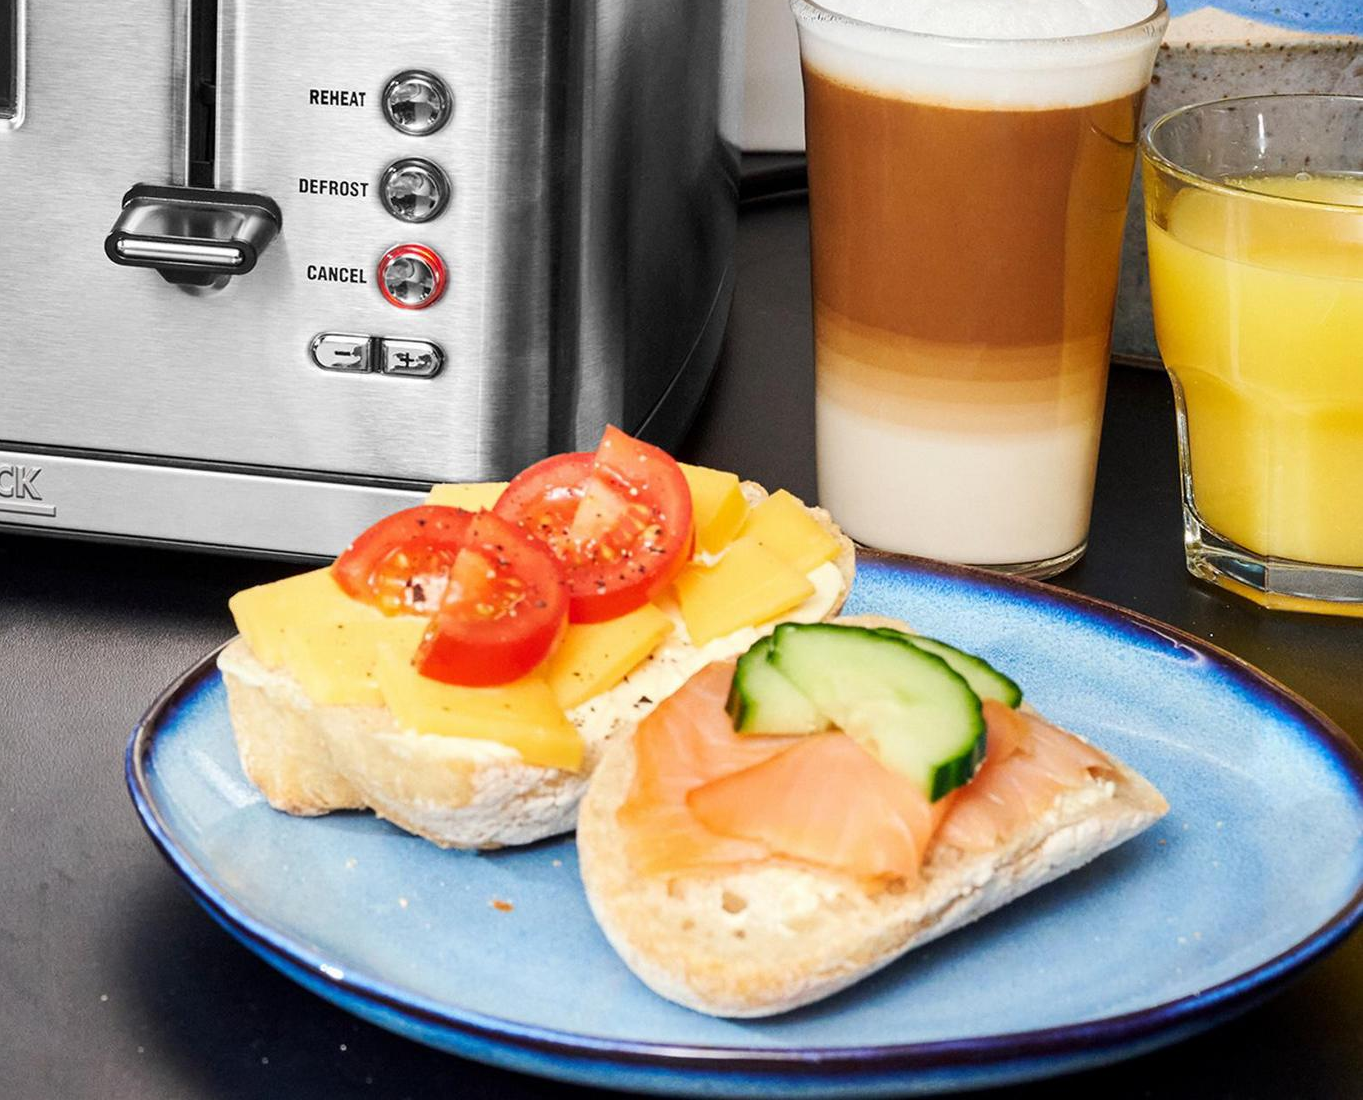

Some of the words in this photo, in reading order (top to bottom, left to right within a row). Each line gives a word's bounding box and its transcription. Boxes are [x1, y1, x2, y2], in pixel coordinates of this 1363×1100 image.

[309, 89, 367, 107] REHEAT
[299, 178, 369, 197] DEFROST
[307, 265, 367, 284] CANCEL
